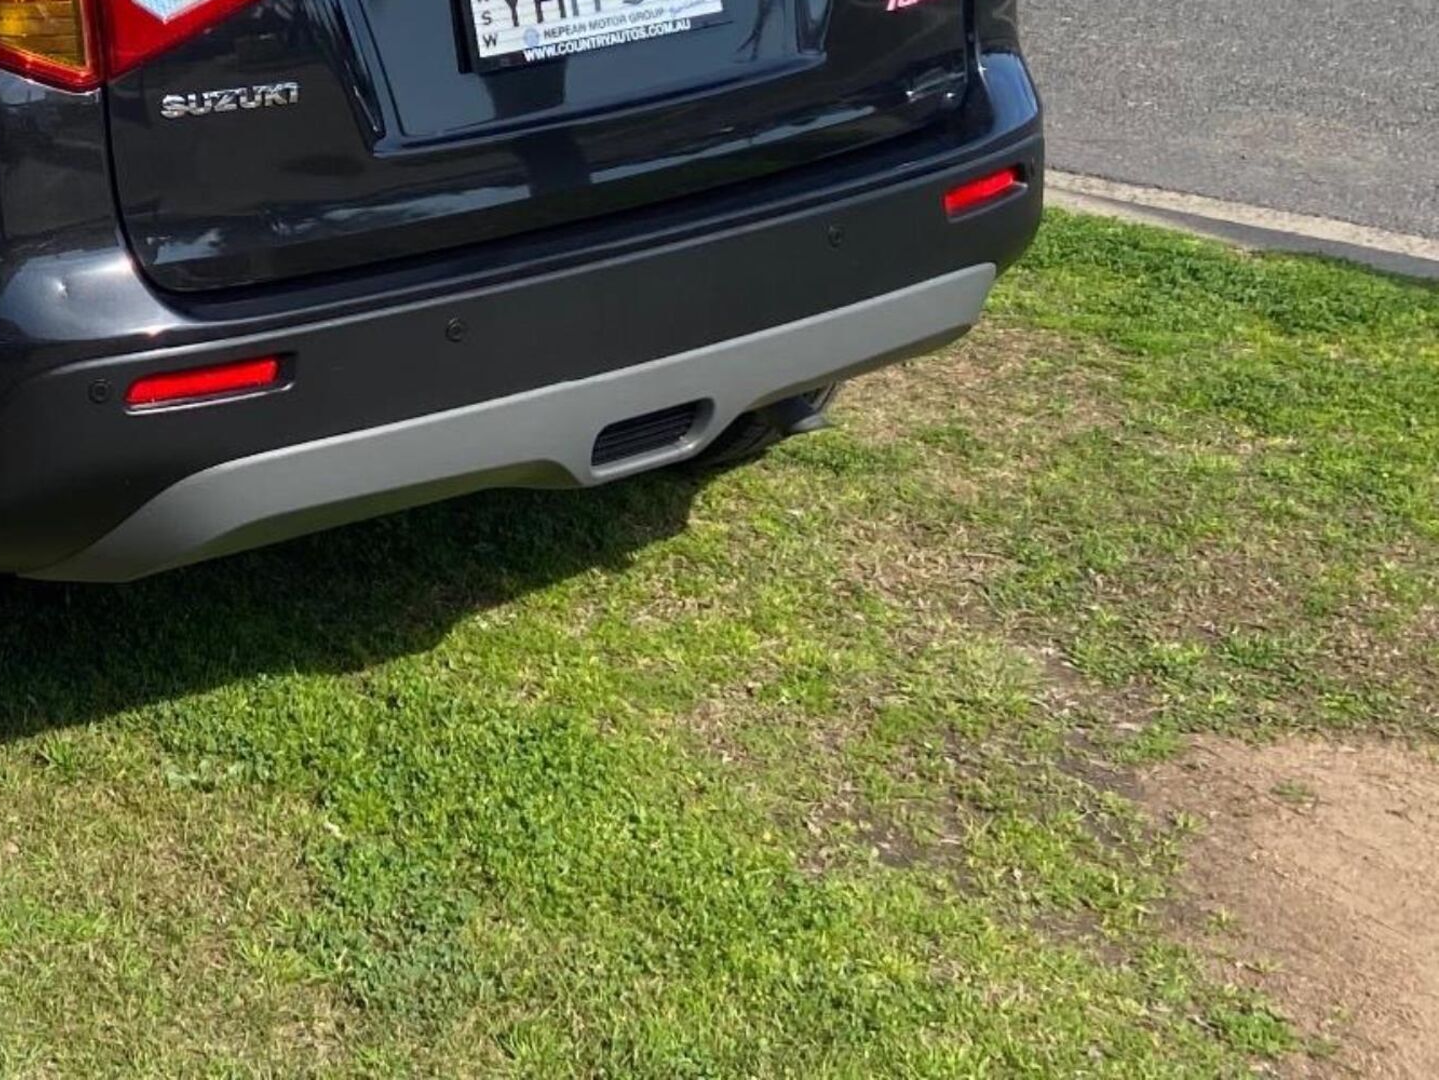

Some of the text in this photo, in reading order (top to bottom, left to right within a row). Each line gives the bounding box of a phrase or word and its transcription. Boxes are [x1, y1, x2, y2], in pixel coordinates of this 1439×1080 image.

[523, 19, 691, 62] WWW.COUNTRYAUTOS.COM.AU
[544, 8, 664, 39] NEPEAN MOTOR GROUP
[160, 81, 299, 118] SUZUKI
